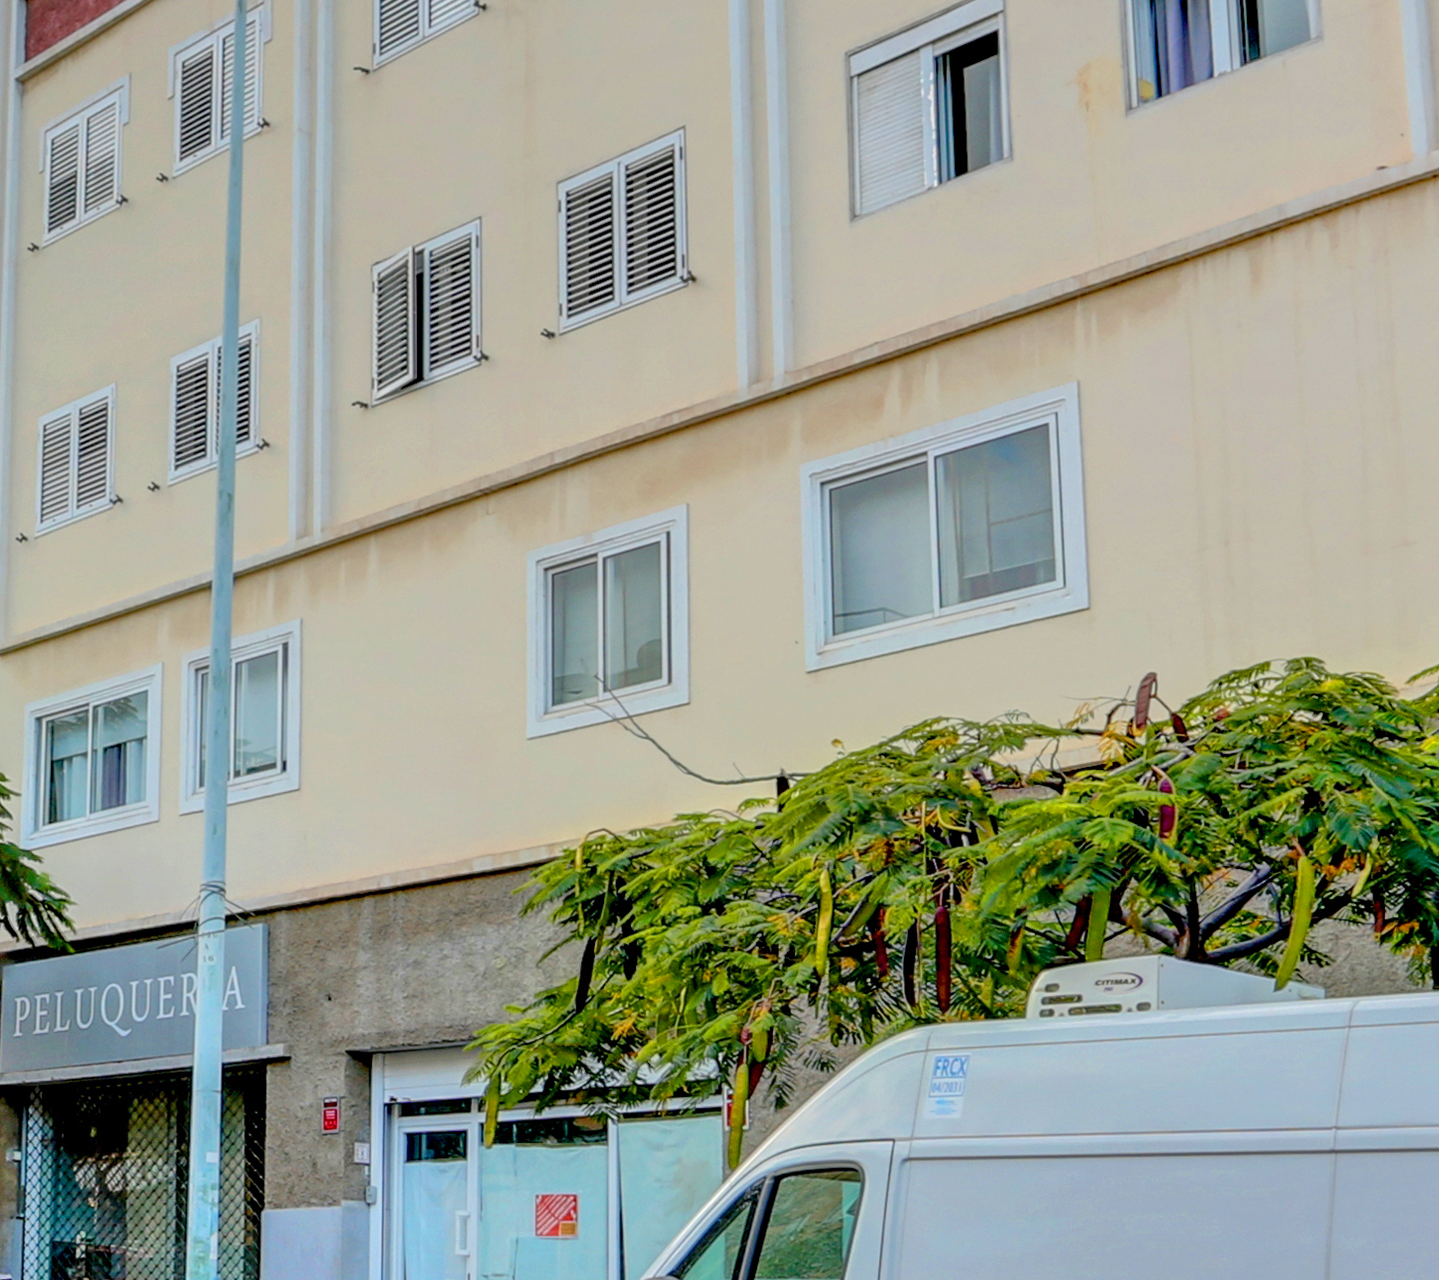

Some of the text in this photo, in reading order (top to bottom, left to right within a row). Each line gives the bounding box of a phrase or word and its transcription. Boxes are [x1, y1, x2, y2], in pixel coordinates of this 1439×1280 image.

[1094, 978, 1137, 986] CITIMAX
[13, 965, 246, 1037] PELUQUERA
[933, 1057, 969, 1077] FRCX
